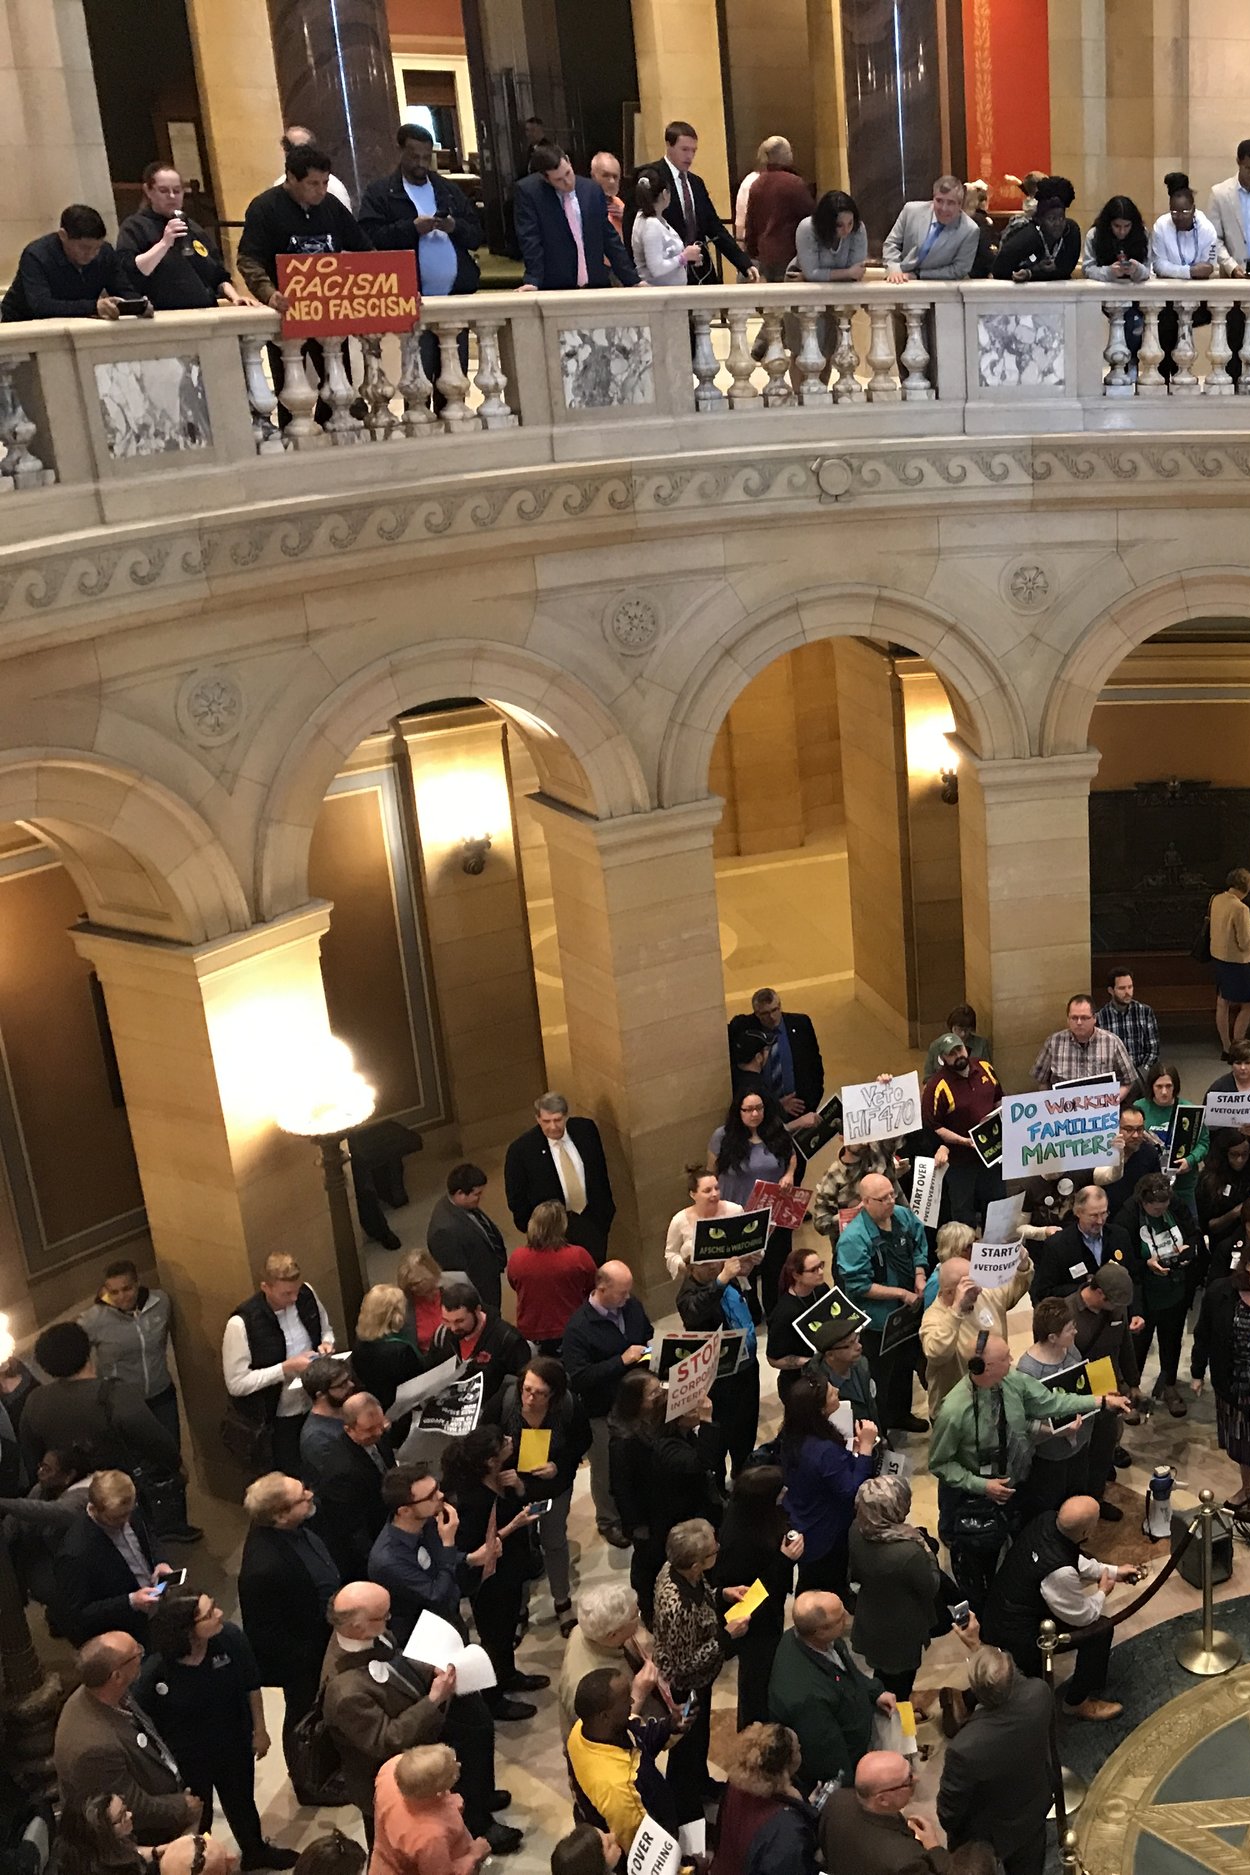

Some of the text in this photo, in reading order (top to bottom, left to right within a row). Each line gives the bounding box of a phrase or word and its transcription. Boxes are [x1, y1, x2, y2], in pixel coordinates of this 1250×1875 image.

[286, 256, 338, 273] NO
[283, 273, 398, 298] RACISM
[286, 296, 417, 321] NEO FASCISM
[1217, 1094, 1245, 1103] START
[1010, 1102, 1037, 1123] DO
[1027, 1112, 1119, 1142] FAMILIES
[912, 1163, 927, 1215] START OVER
[981, 1247, 1013, 1258] START
[677, 1333, 720, 1383] STOP
[632, 1831, 654, 1872] OVER
[650, 1841, 674, 1875] THING
